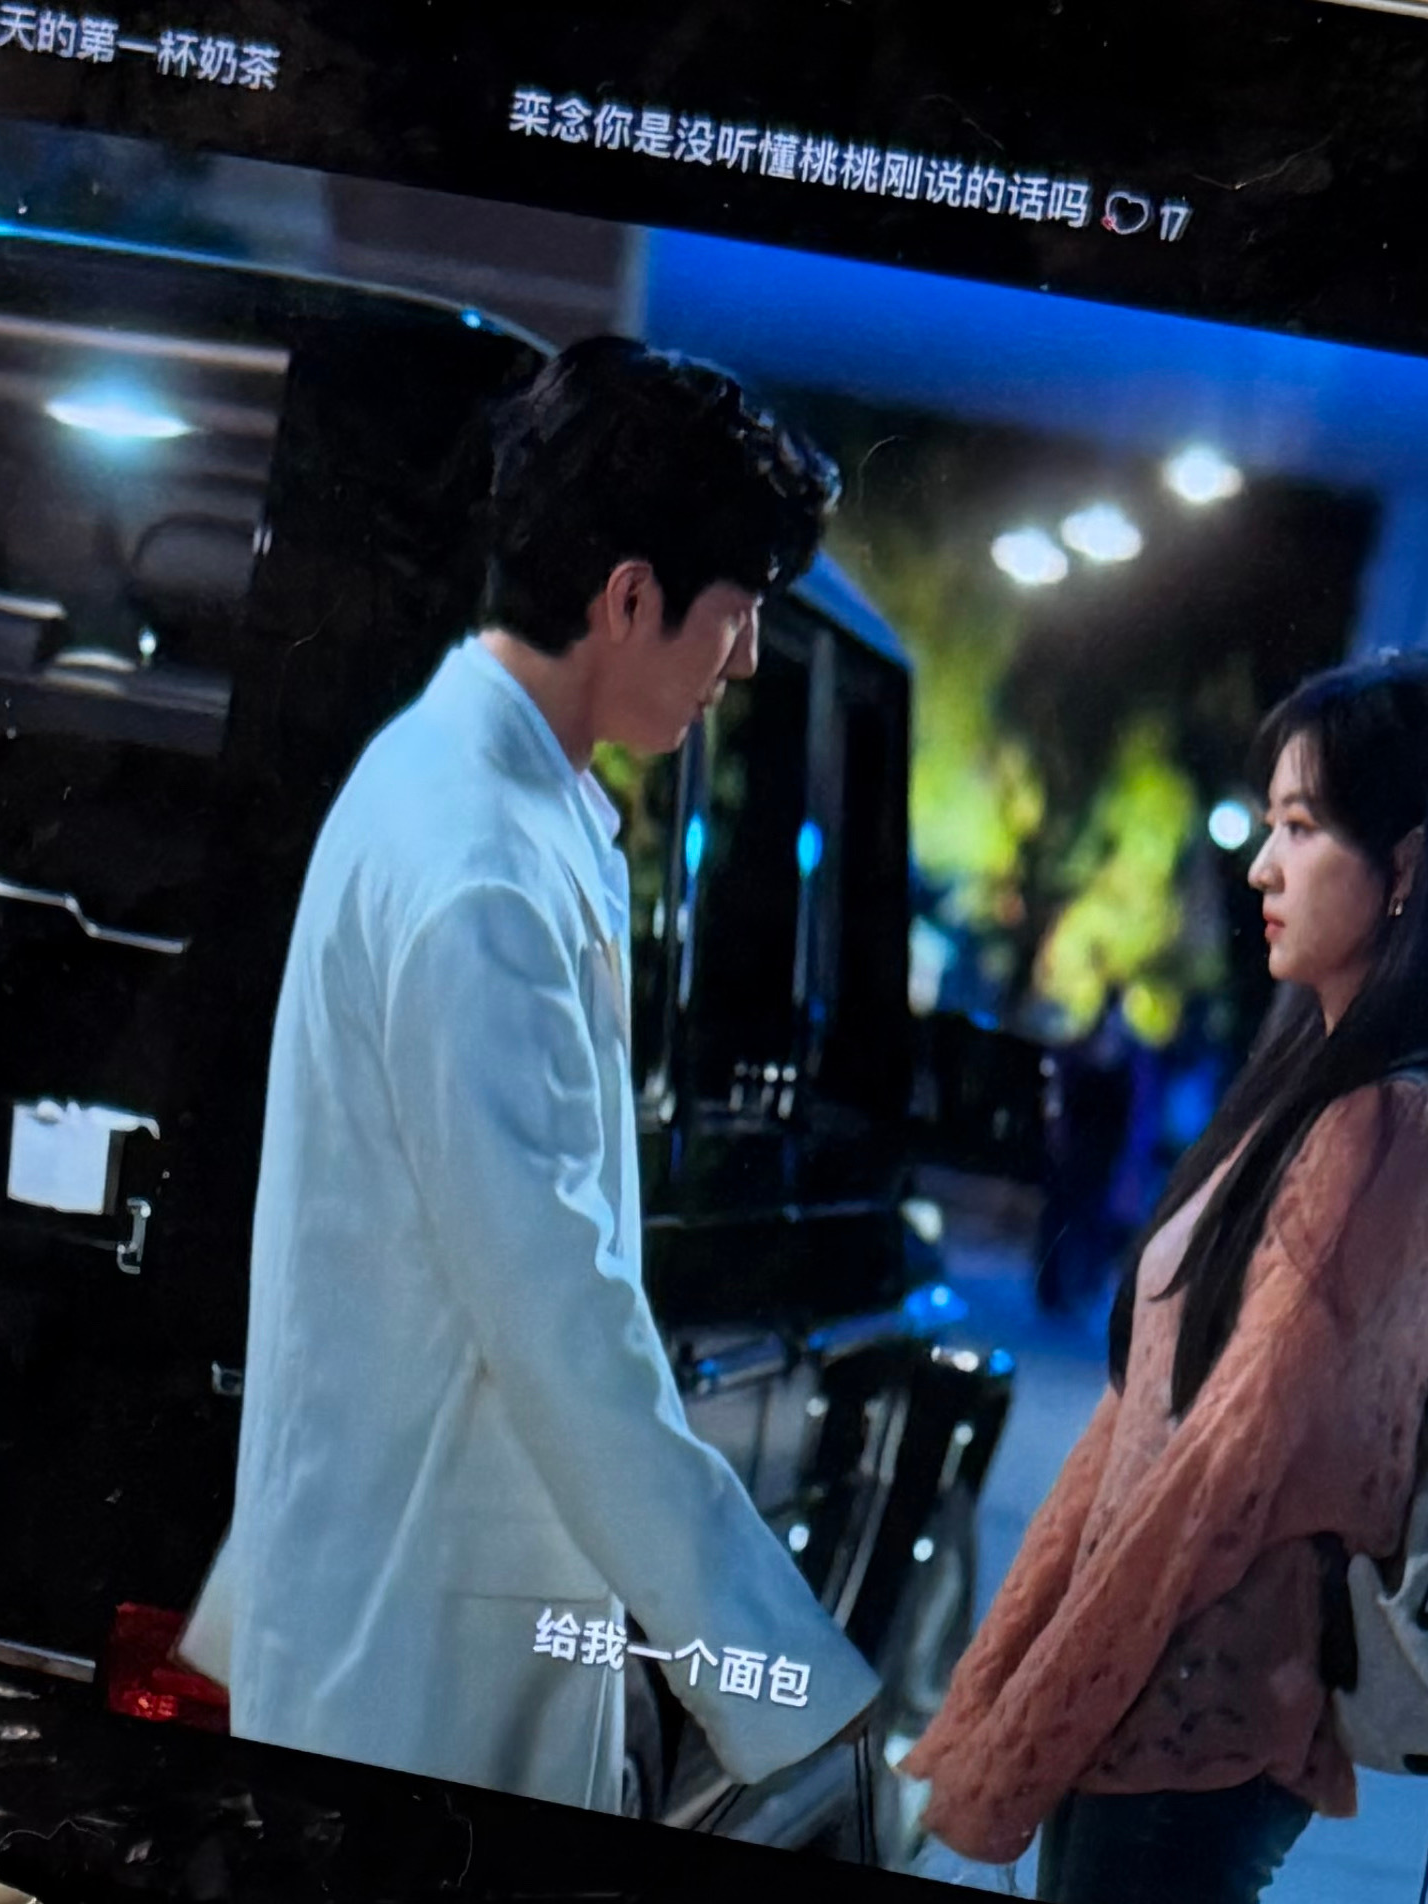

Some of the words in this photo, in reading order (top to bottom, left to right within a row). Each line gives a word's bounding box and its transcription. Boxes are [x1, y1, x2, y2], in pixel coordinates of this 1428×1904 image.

[509, 88, 1091, 228] 栾念你是没听懂桃桃刚说的话吗
[1159, 203, 1190, 242] 17
[532, 1607, 812, 1708] 给我一个面包
